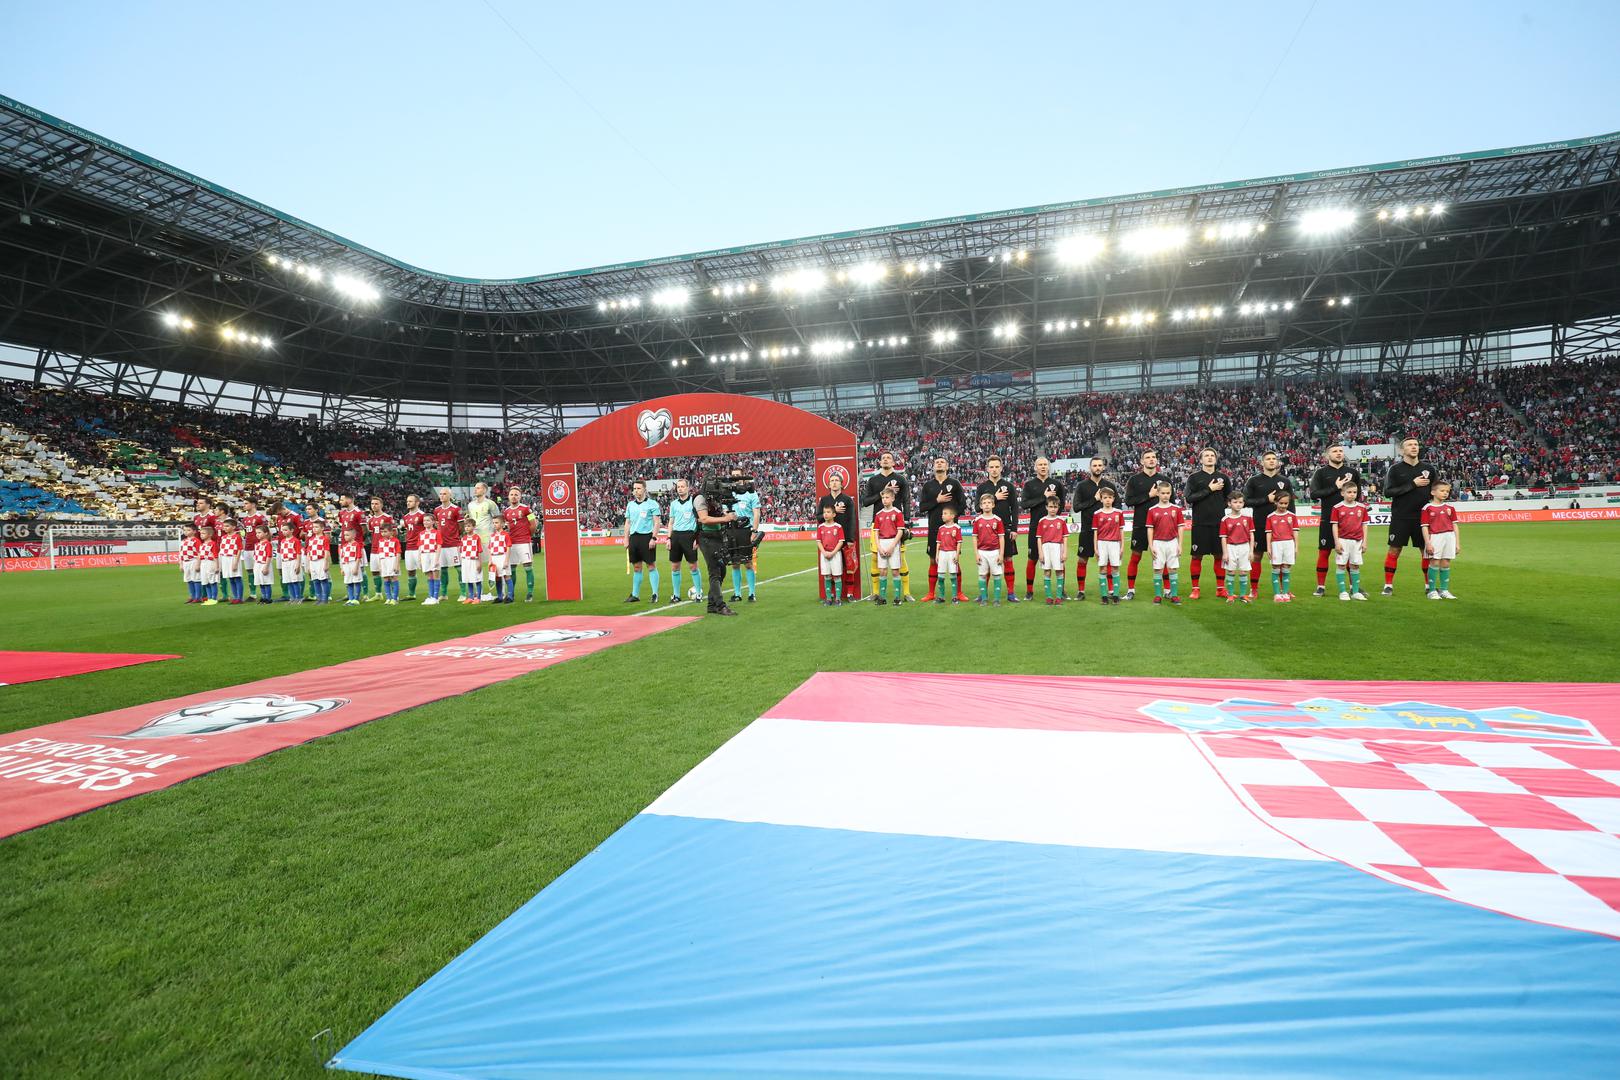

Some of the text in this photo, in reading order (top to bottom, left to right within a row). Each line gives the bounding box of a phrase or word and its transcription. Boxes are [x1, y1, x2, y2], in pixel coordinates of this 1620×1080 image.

[68, 125, 108, 146] Groupama
[1511, 145, 1546, 154] Groupama
[1407, 157, 1440, 167] Groupama
[679, 412, 733, 426] EUROPEAN
[672, 423, 741, 440] QUALIFIERS
[545, 508, 575, 516] RESPECT
[441, 518, 446, 526] 2
[0, 523, 31, 539] EG
[58, 544, 114, 556] BRIGADE
[453, 555, 459, 564] 2
[0, 738, 191, 769] EUROPEAN
